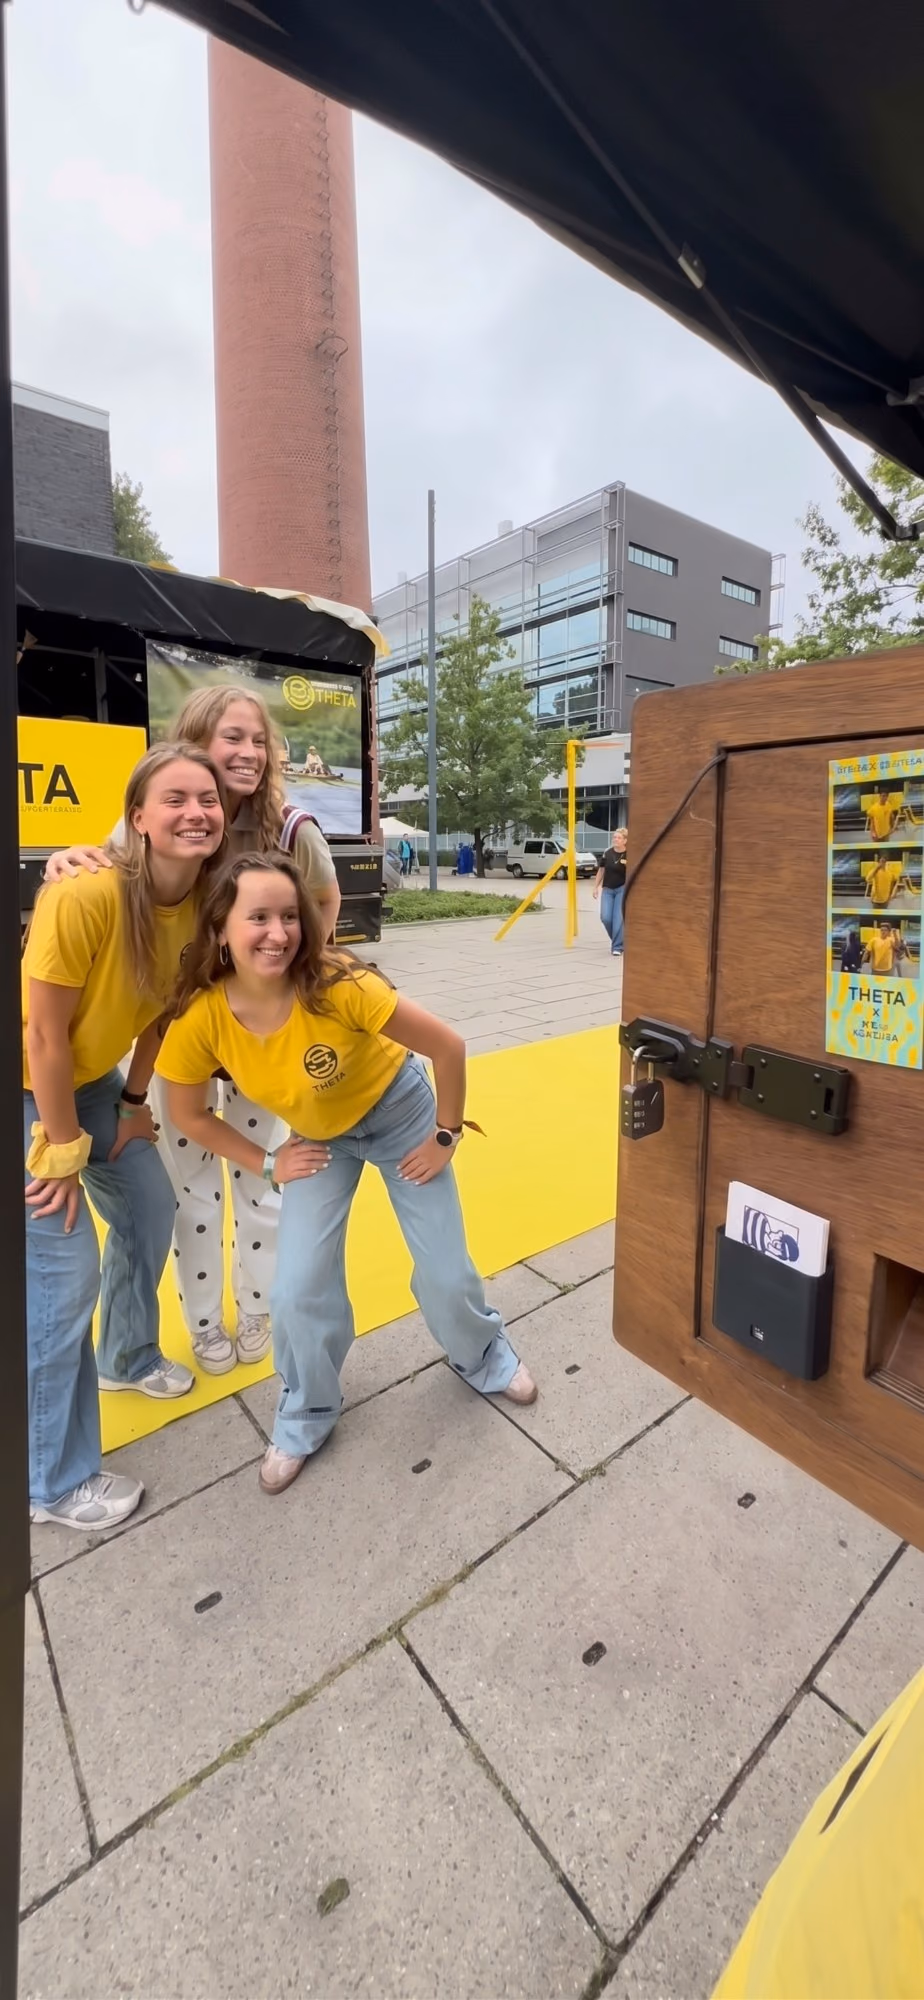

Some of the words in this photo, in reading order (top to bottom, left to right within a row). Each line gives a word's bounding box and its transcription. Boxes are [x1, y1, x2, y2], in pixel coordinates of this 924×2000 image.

[315, 689, 356, 708] THETA
[848, 986, 906, 1007] THETA
[312, 1072, 346, 1093] THETA
